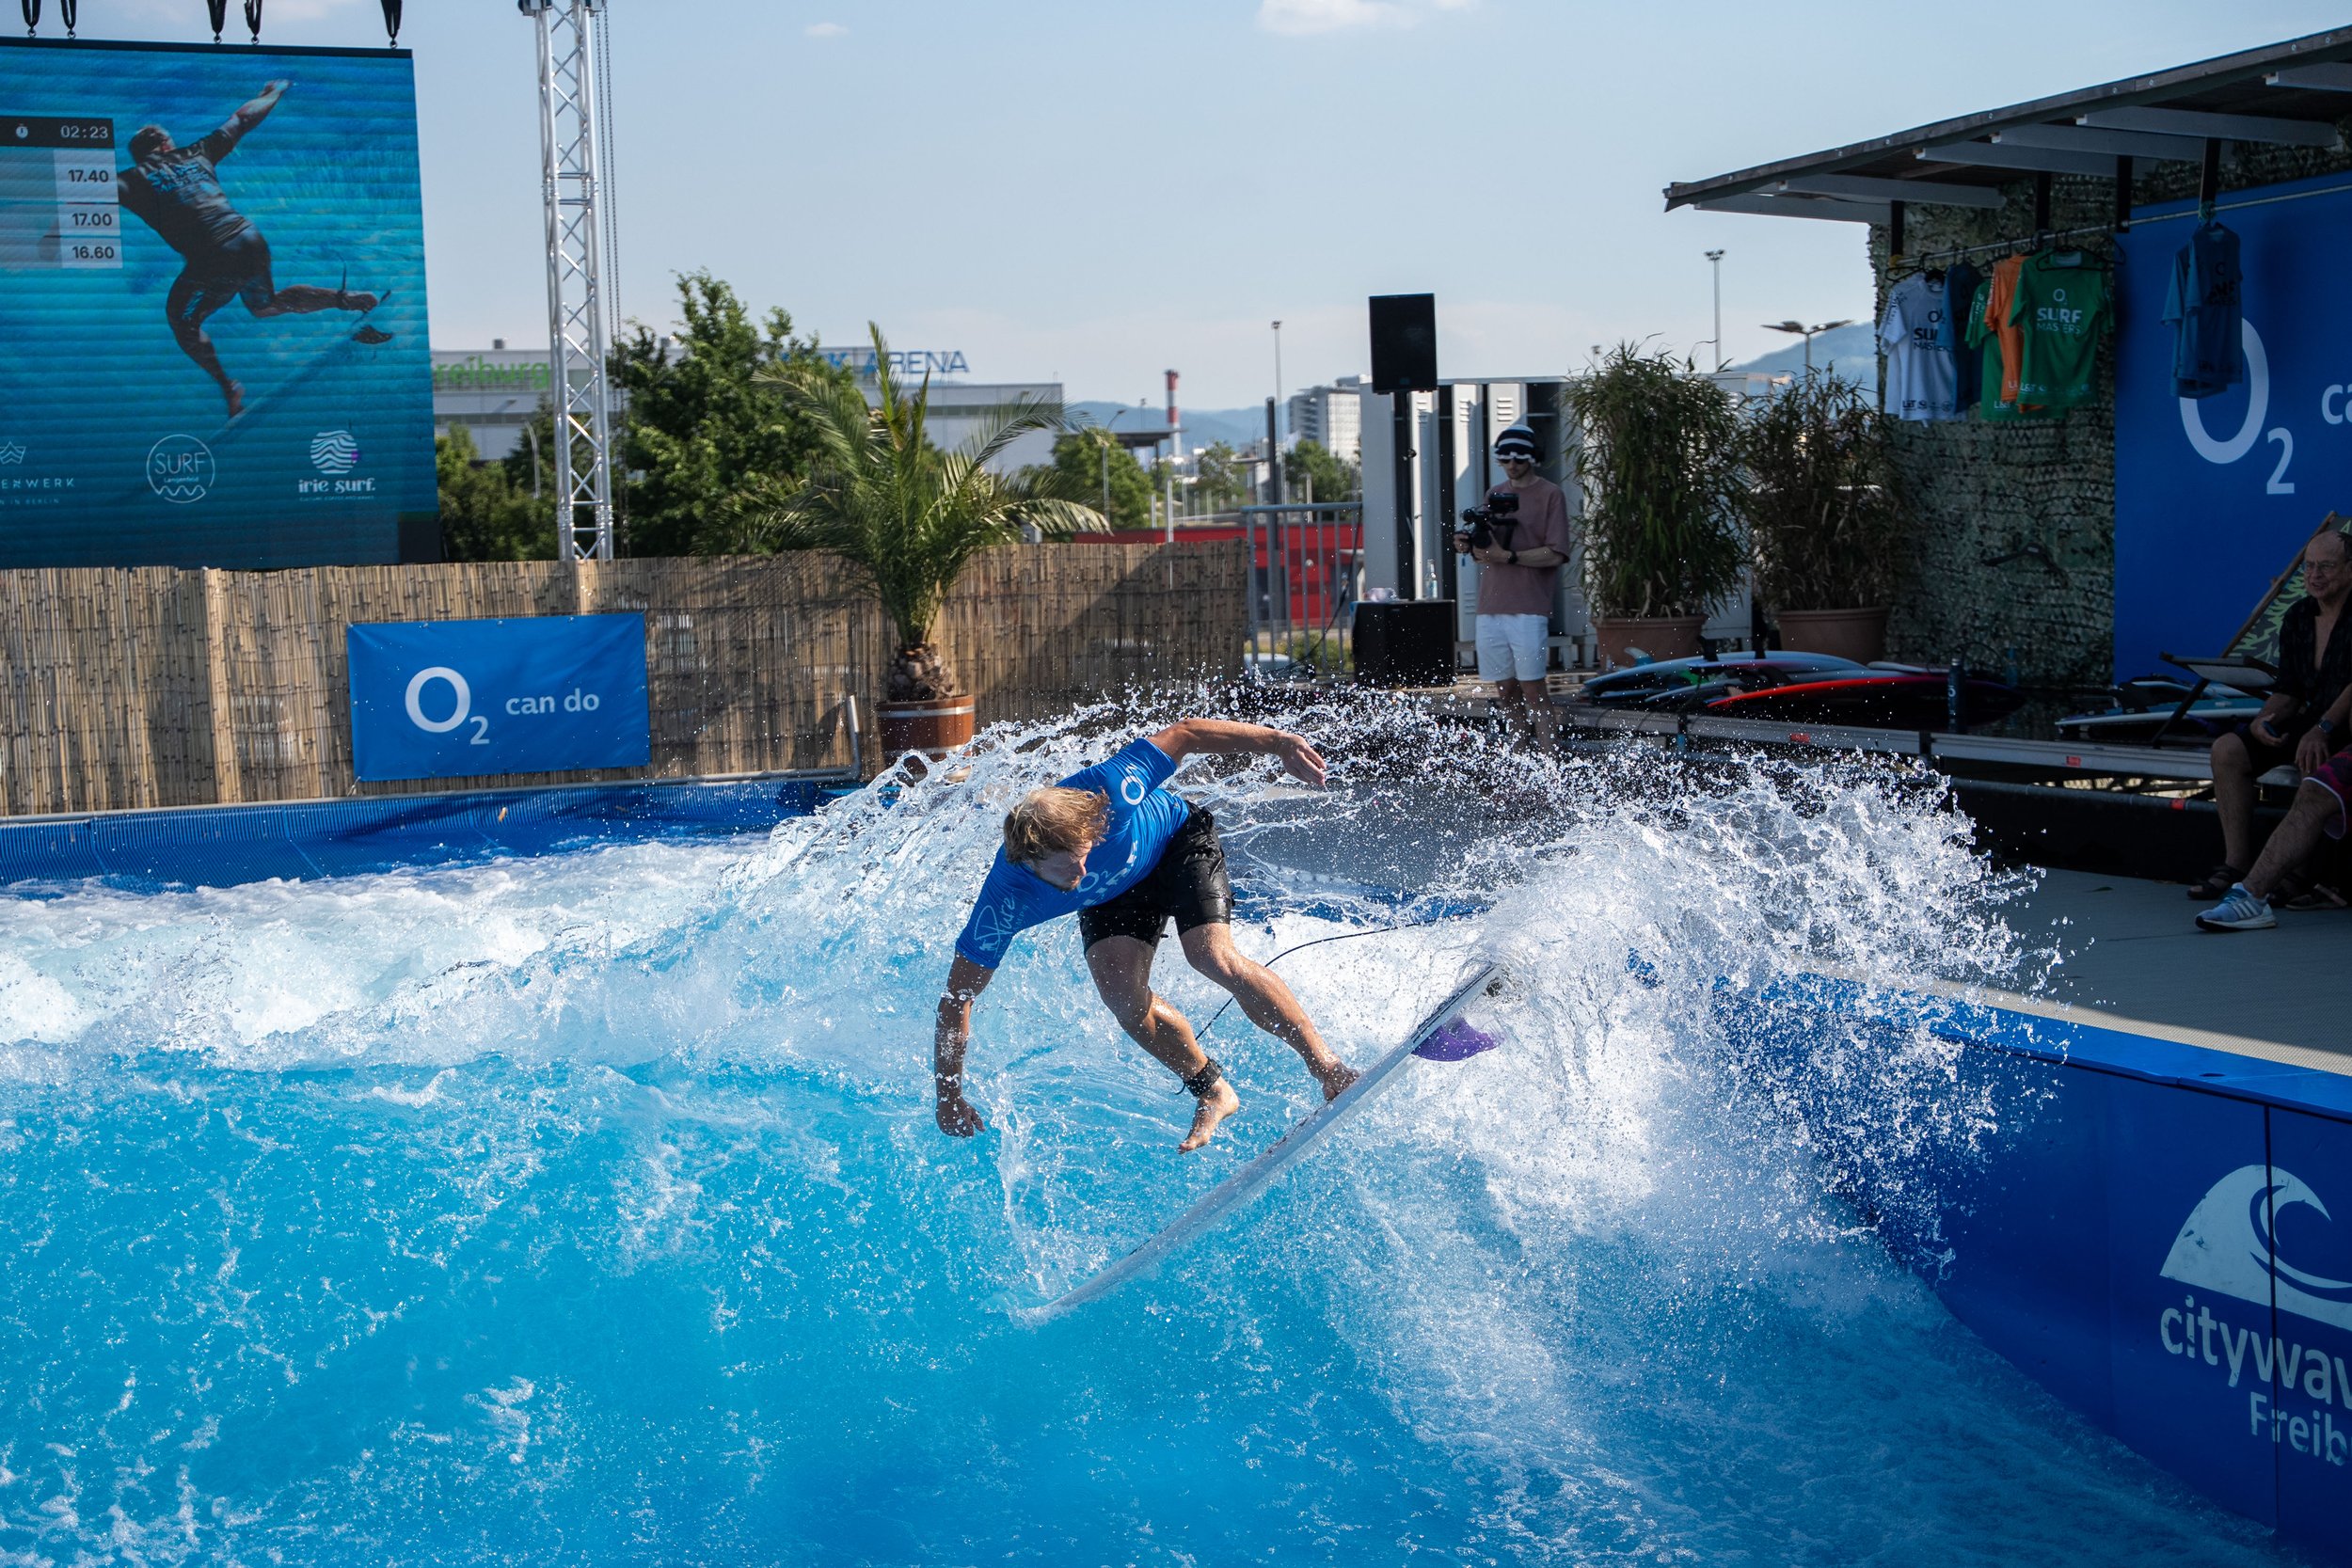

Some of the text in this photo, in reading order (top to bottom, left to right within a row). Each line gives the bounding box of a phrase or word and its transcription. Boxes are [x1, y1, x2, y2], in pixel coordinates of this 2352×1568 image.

[60, 125, 108, 138] 02:23
[68, 169, 109, 182] 17.40
[72, 213, 112, 226] 17.00
[72, 245, 115, 259] 16.60
[2037, 308, 2083, 324] SURF
[1914, 327, 1939, 341] SU
[864, 350, 970, 373] ARENA
[436, 354, 550, 390] reiburg
[154, 451, 206, 474] SURF
[298, 478, 329, 493] irie
[505, 695, 555, 715] can
[564, 688, 600, 713] do
[974, 895, 1016, 942] Pure
[2249, 1391, 2352, 1466] Freib
